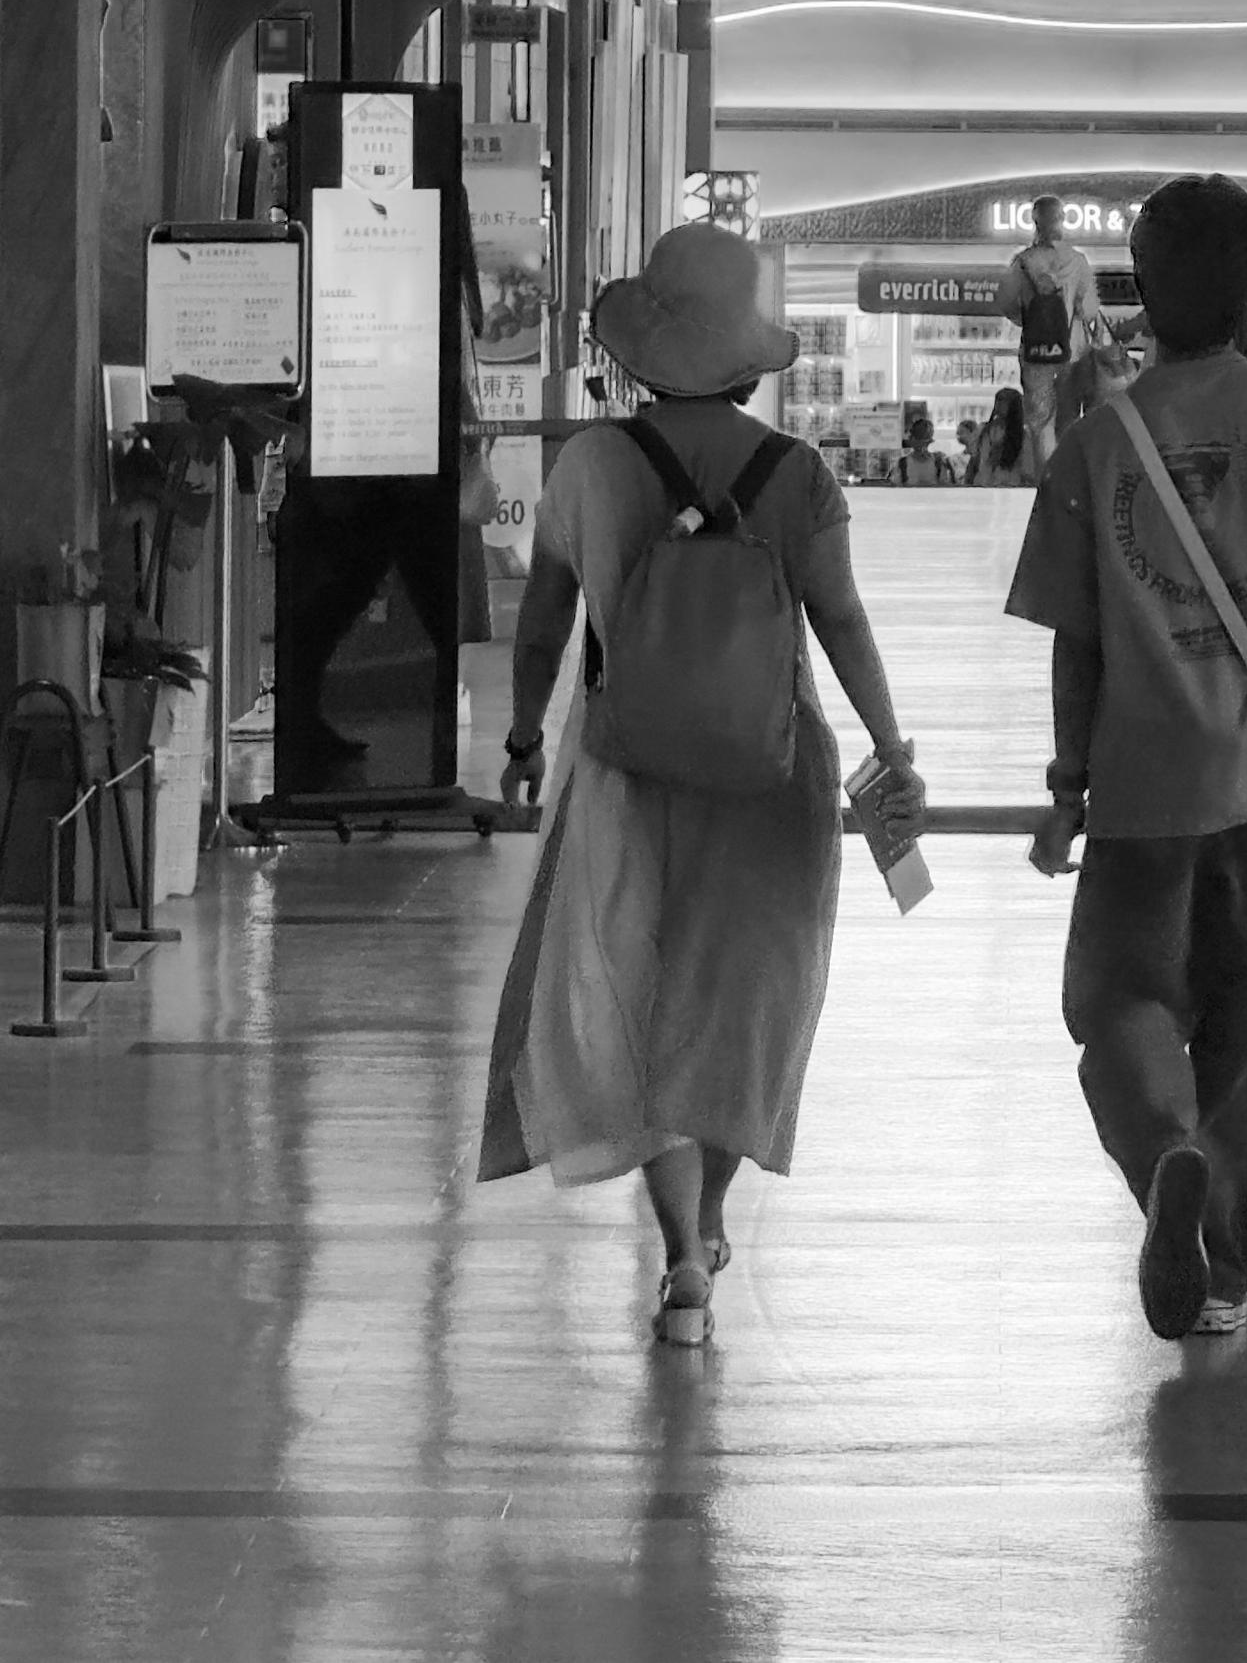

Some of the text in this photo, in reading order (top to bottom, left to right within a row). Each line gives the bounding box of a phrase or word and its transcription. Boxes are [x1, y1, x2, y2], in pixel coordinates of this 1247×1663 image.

[993, 202, 1102, 231] LIOR
[1106, 208, 1124, 231] &
[879, 278, 961, 302] everrich
